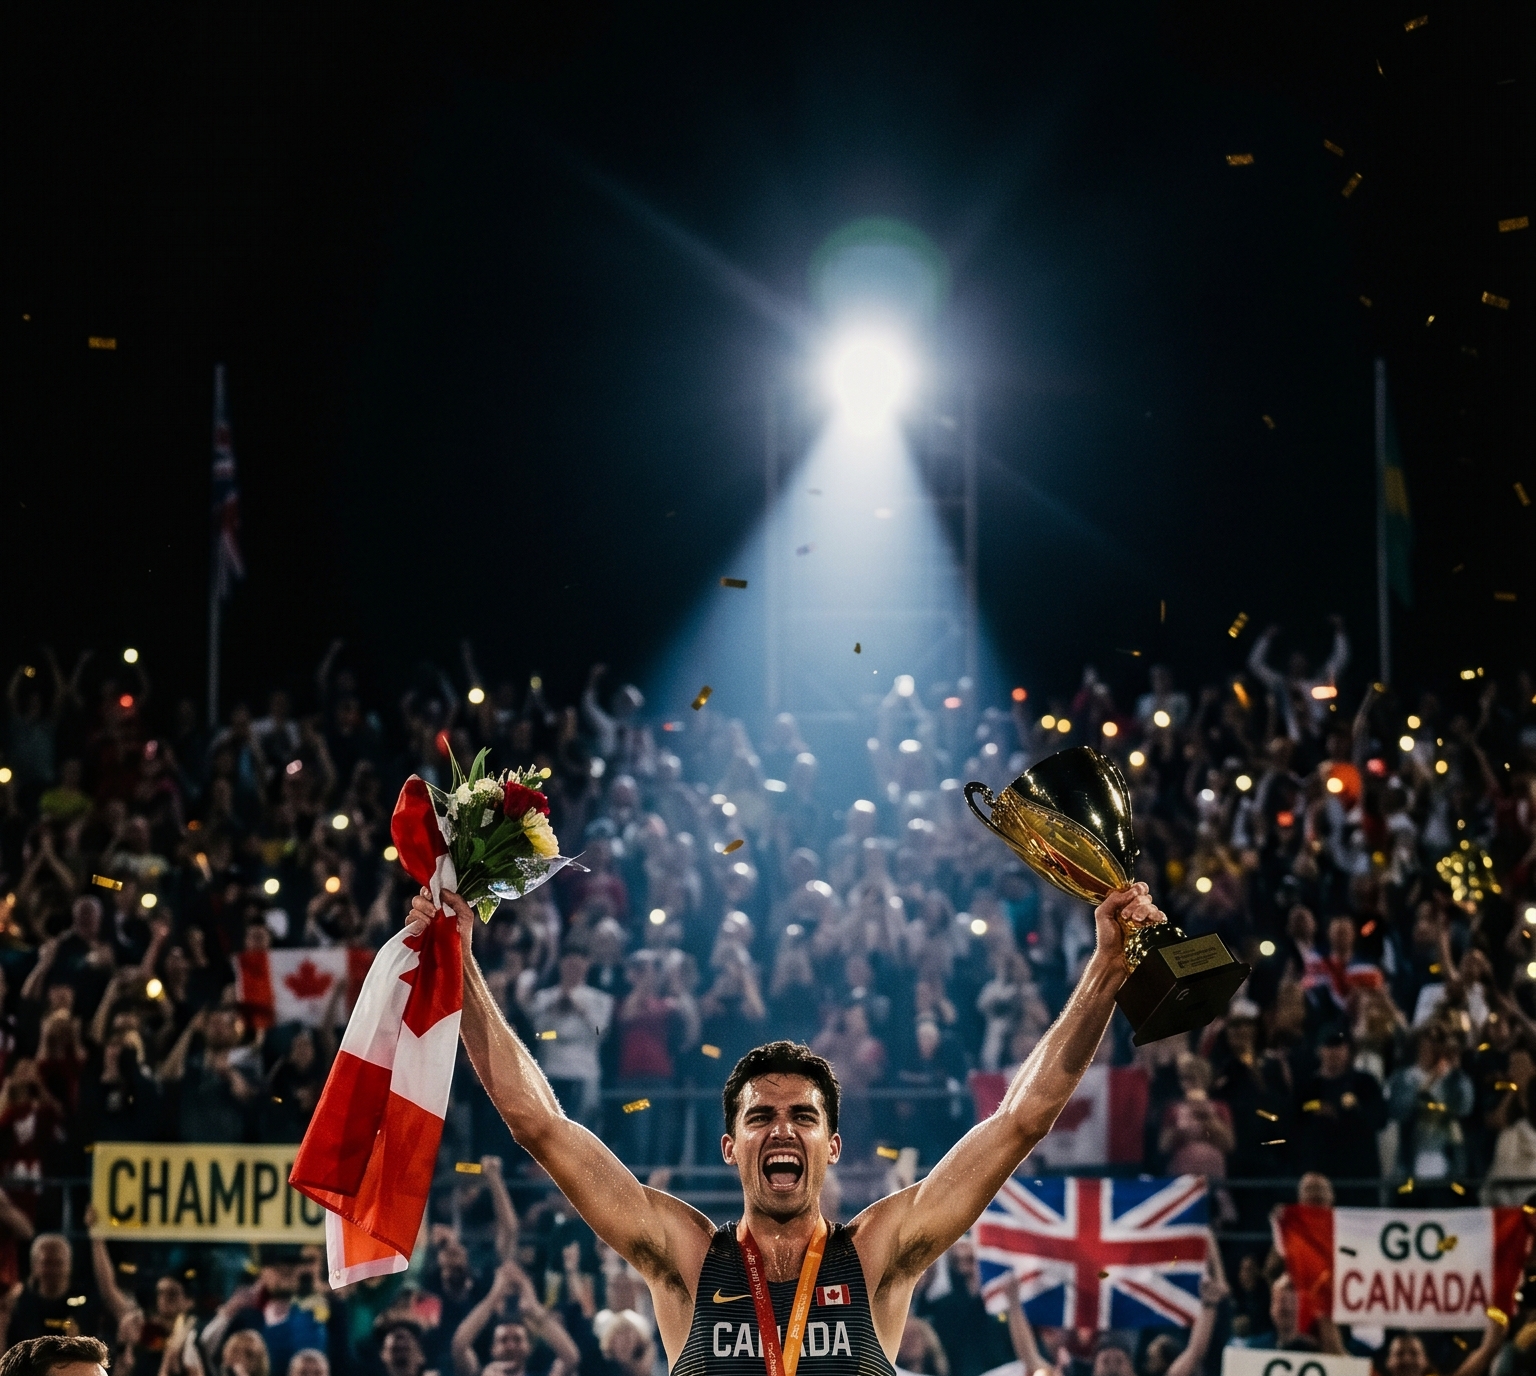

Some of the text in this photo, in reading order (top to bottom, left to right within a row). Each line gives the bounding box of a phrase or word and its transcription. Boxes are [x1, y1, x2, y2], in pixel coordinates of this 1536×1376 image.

[1380, 1222, 1446, 1261] GO
[1340, 1270, 1490, 1314] CANADA
[713, 1321, 852, 1357] CADA
